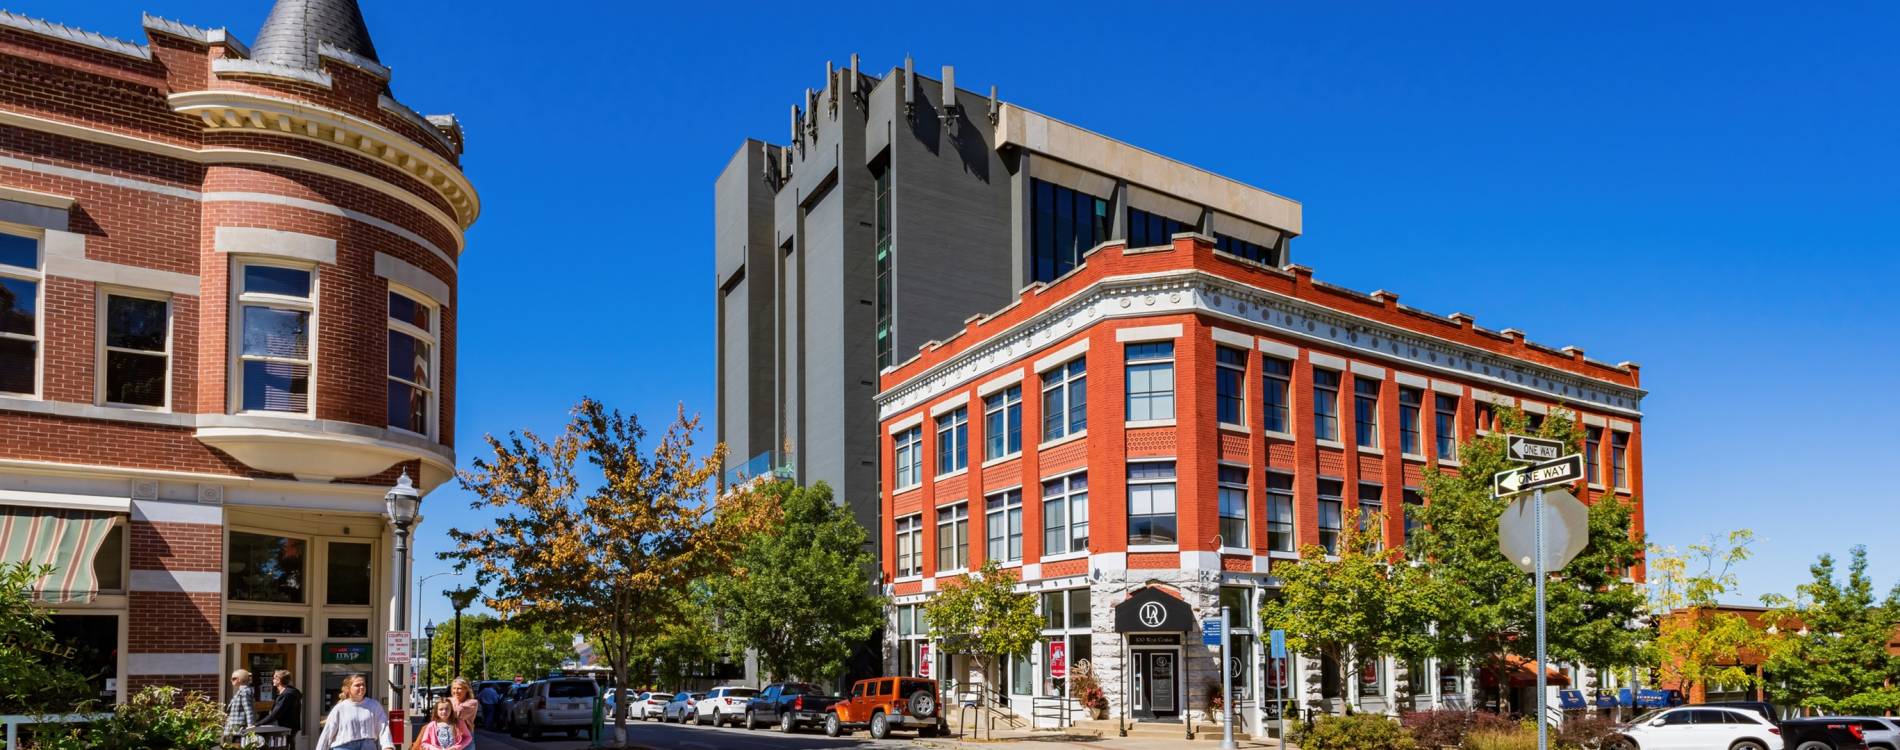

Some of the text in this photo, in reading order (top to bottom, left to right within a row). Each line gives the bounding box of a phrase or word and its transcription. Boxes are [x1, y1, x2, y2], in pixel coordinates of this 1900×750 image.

[1523, 444, 1555, 457] ONE WAY
[1518, 464, 1566, 485] ONE WAY
